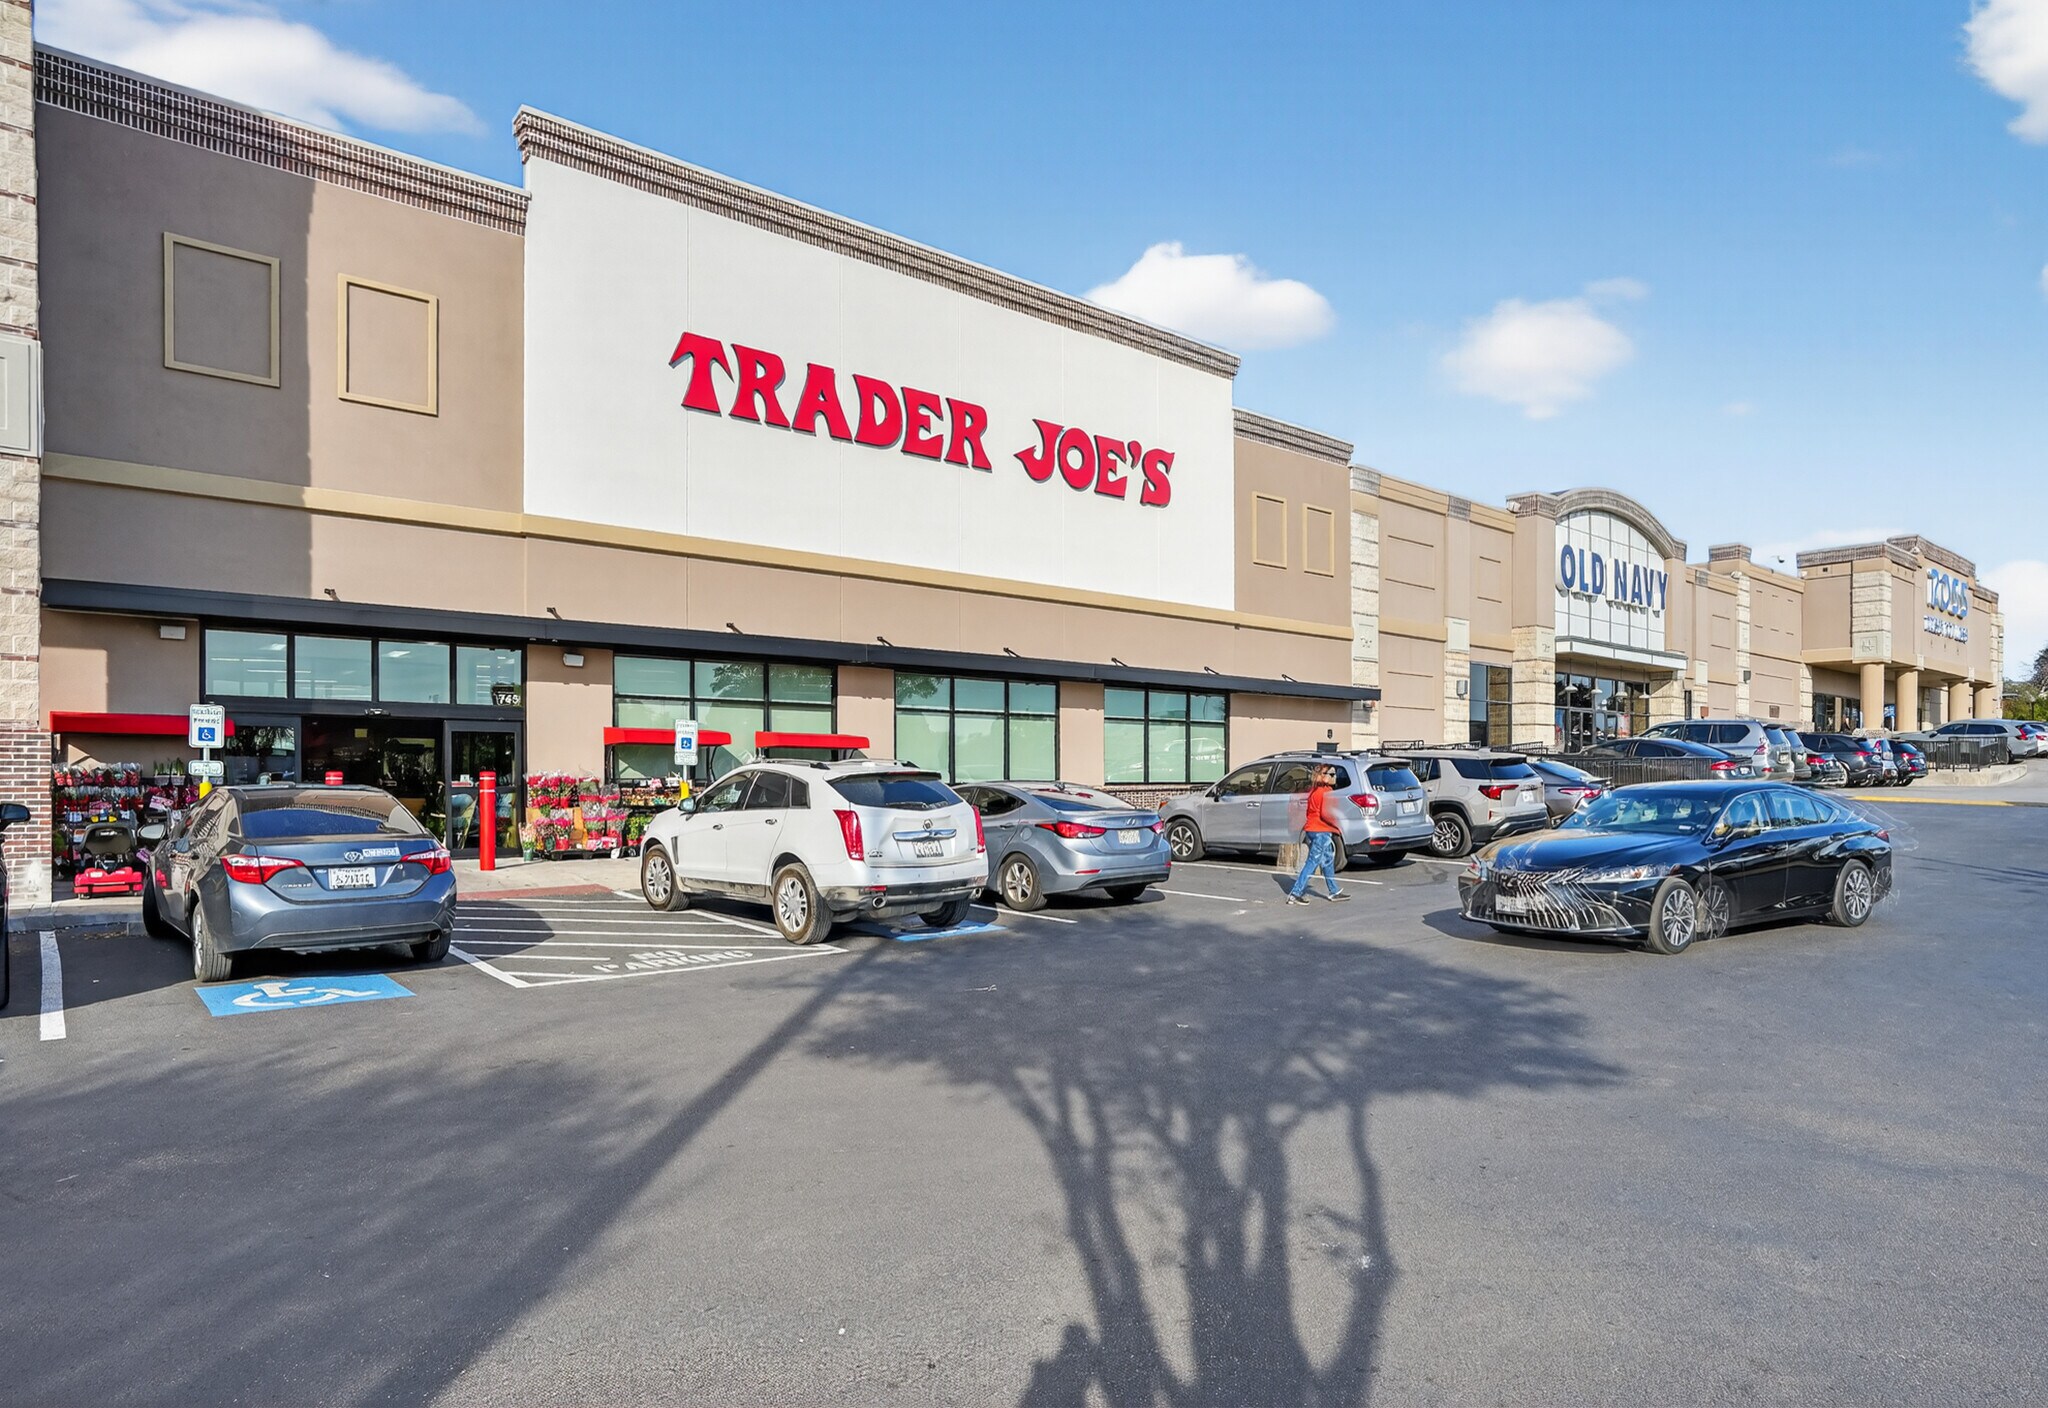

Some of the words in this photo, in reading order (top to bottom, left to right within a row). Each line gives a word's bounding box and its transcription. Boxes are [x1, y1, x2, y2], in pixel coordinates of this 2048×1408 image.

[669, 331, 993, 473] TRADER
[1013, 418, 1176, 508] JOE'S
[1560, 544, 1605, 595] OLD
[1613, 558, 1669, 611] NAVY
